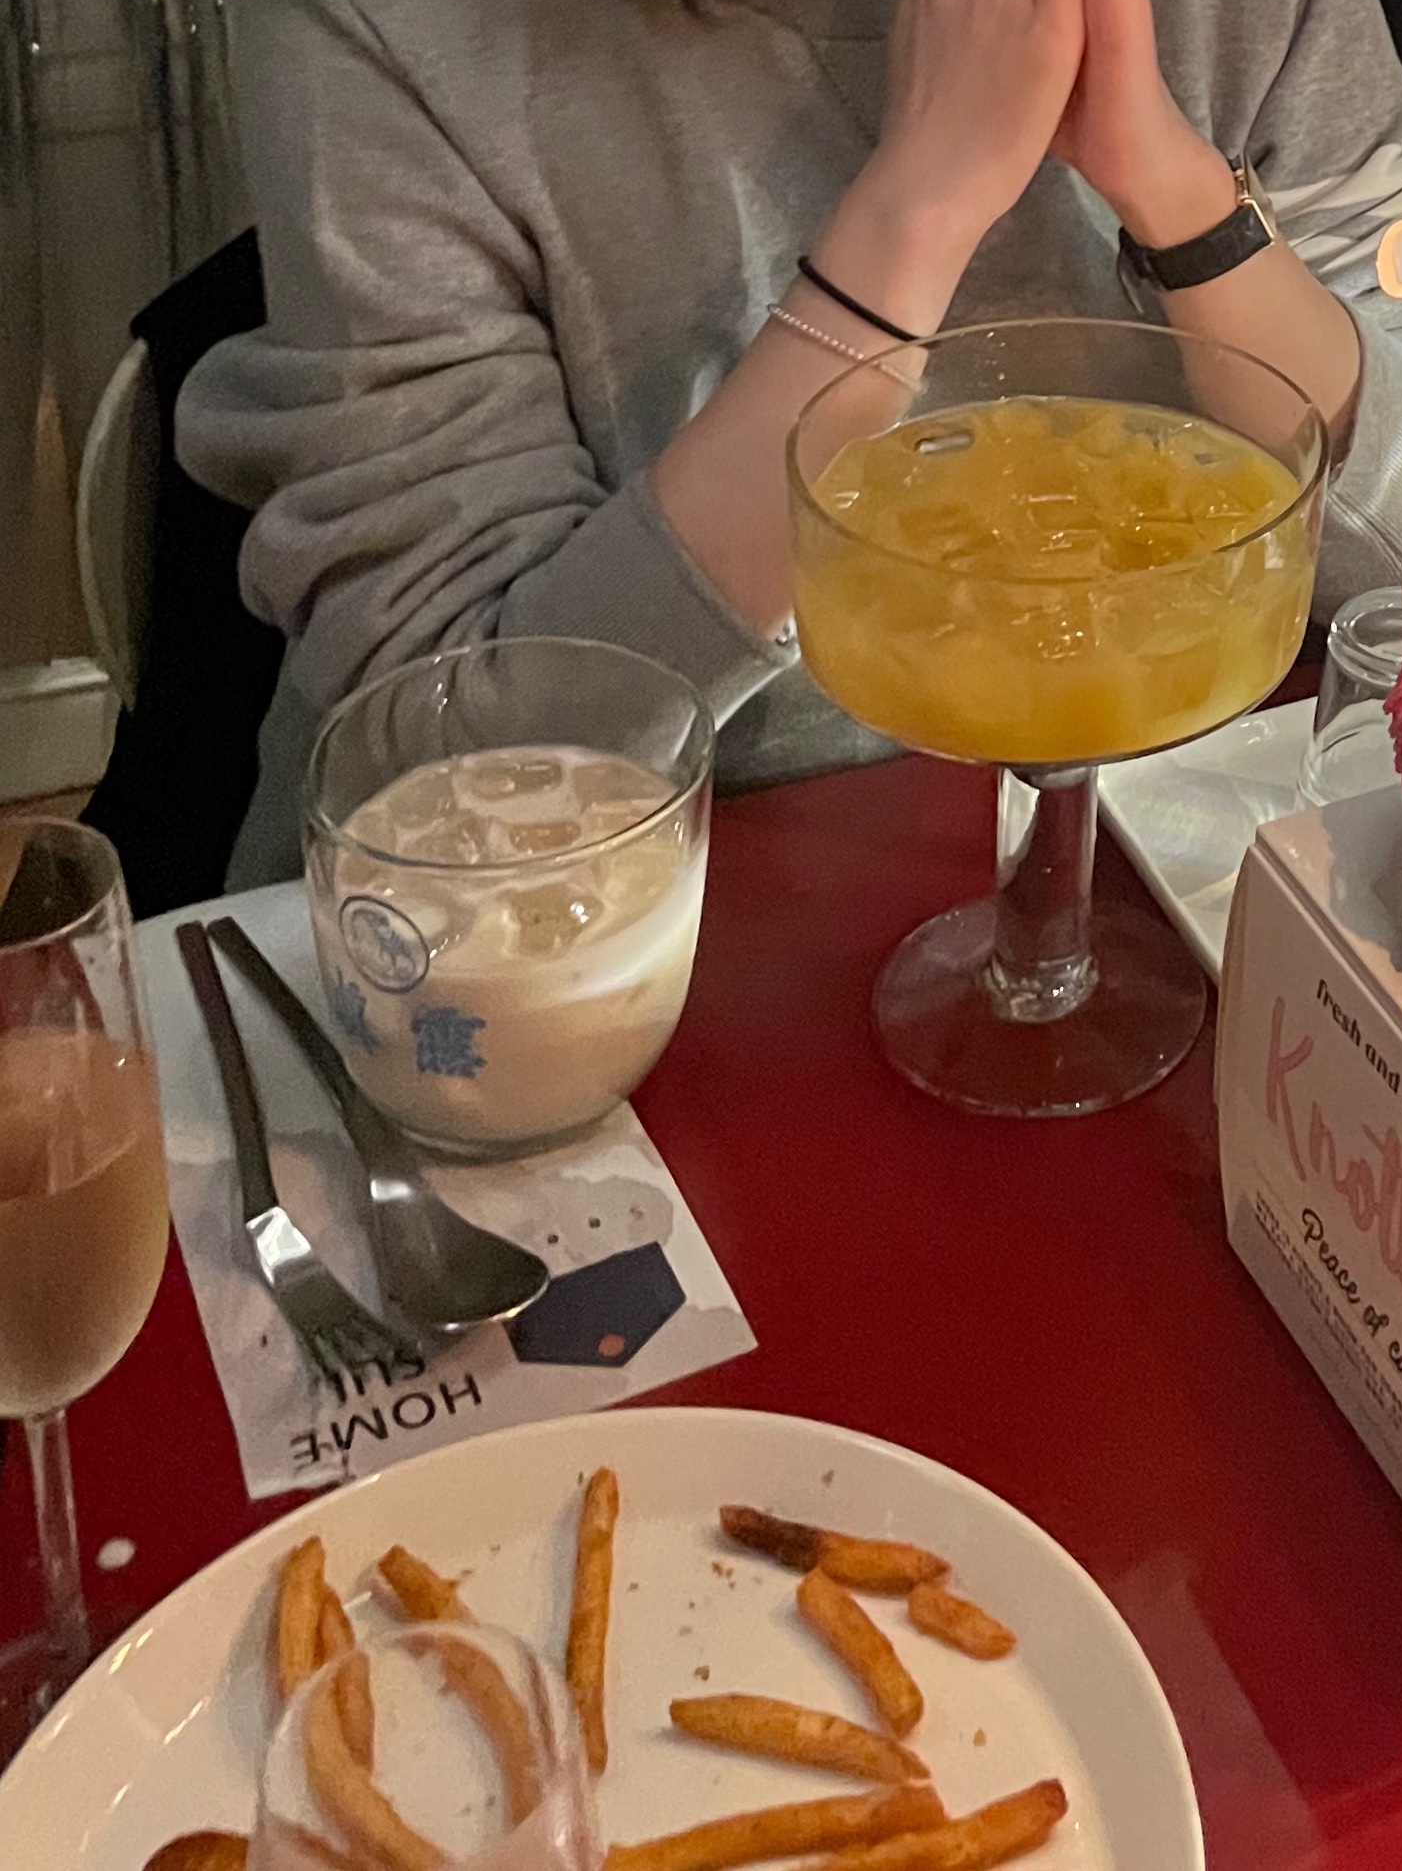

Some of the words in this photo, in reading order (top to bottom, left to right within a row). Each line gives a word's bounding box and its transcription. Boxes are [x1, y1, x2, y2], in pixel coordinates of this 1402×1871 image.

[1316, 978, 1362, 1048] fresh
[1364, 1042, 1401, 1096] and
[1301, 1207, 1361, 1305] Peace
[1362, 1304, 1390, 1338] of
[289, 1372, 482, 1470] HOME
